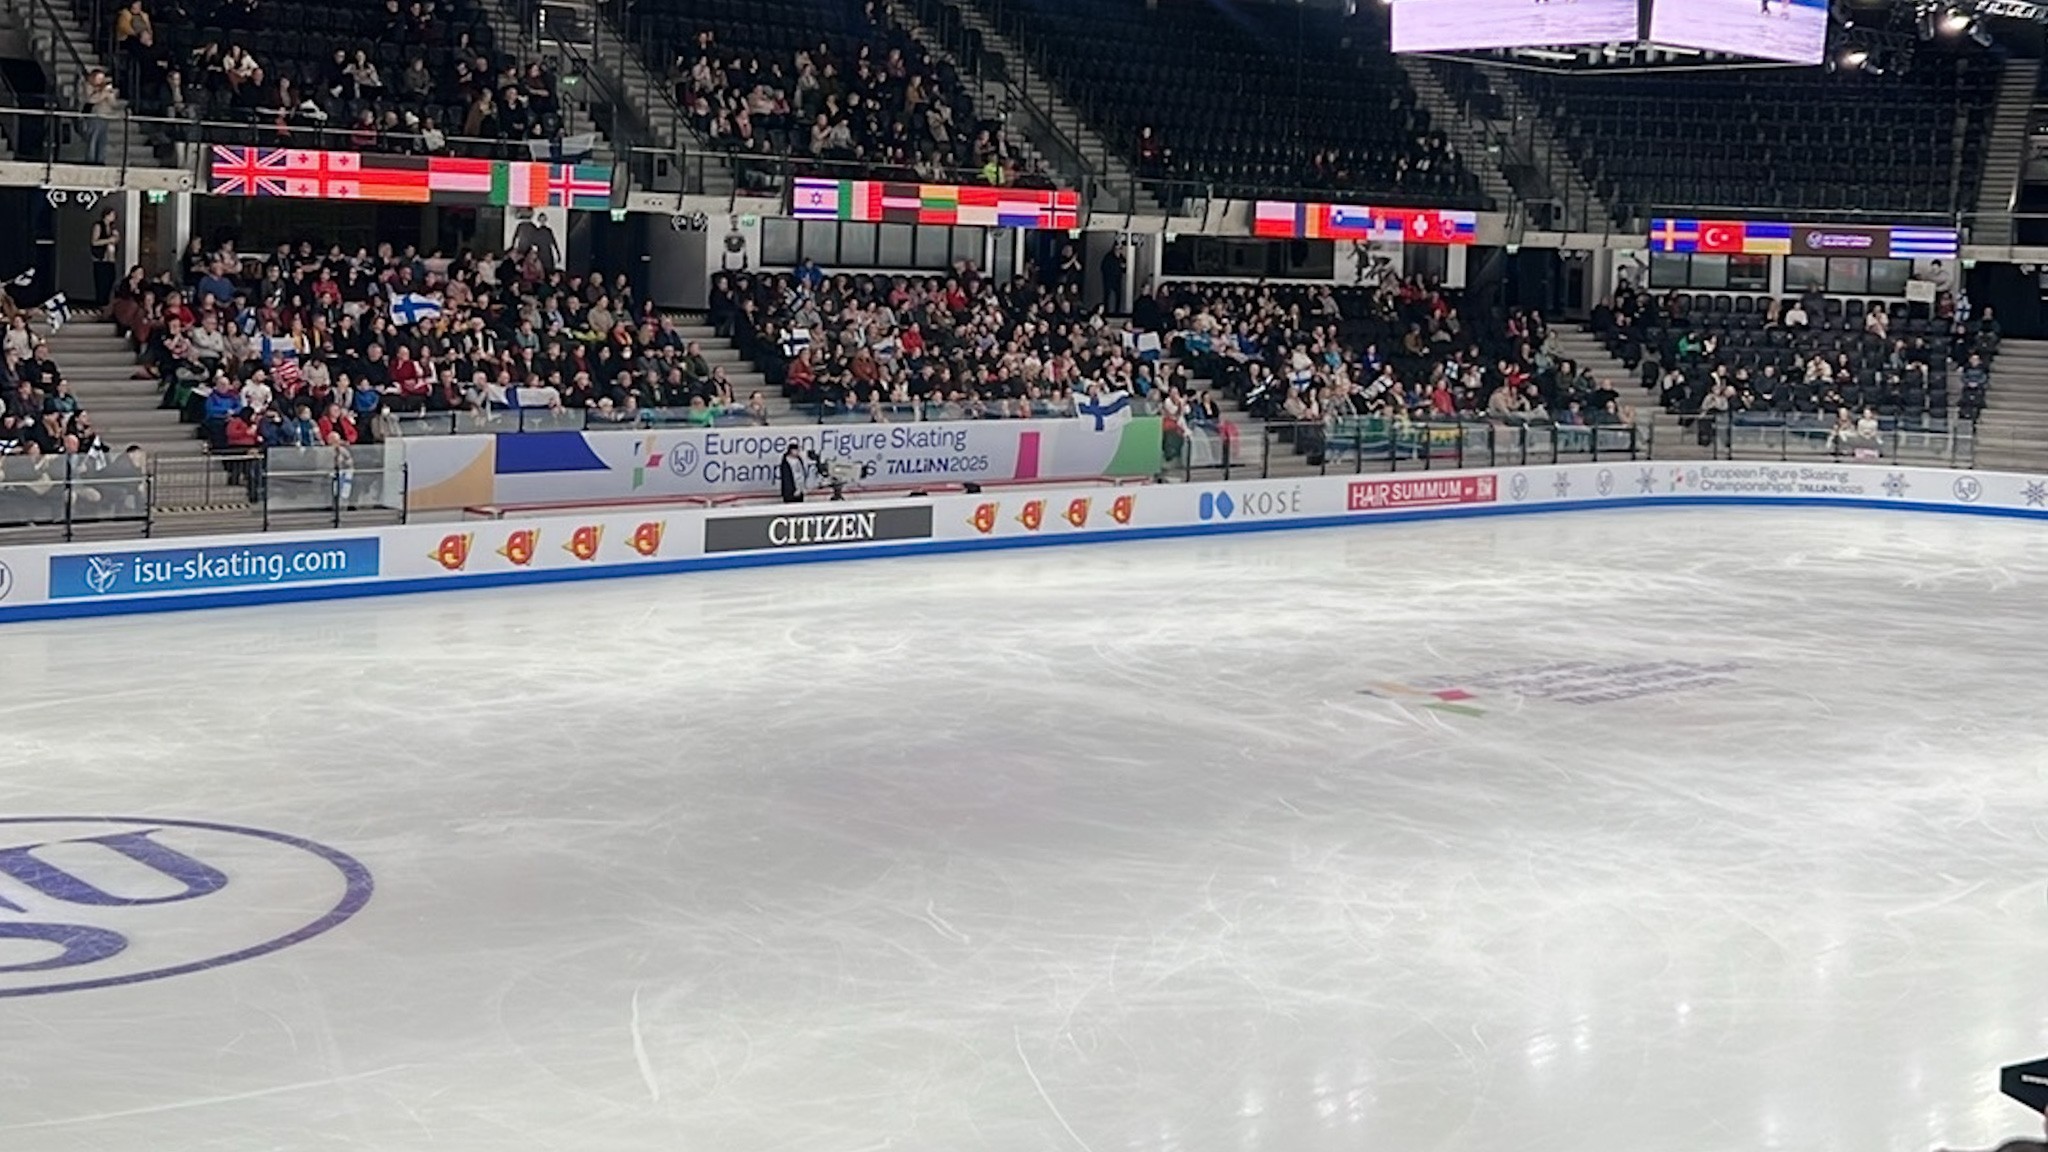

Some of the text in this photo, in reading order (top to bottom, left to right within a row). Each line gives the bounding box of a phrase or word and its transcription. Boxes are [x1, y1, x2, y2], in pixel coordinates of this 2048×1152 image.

[705, 426, 967, 459] European Figure Skating
[1701, 467, 1757, 480] European
[1760, 467, 1797, 481] Figure
[1800, 468, 1848, 483] Skating
[1242, 484, 1302, 516] KOSÉ
[1352, 485, 1390, 508] HAIR
[1391, 480, 1462, 501] SUMMUM
[768, 512, 877, 545] CITIZEN
[133, 549, 347, 583] isu-skating.com
